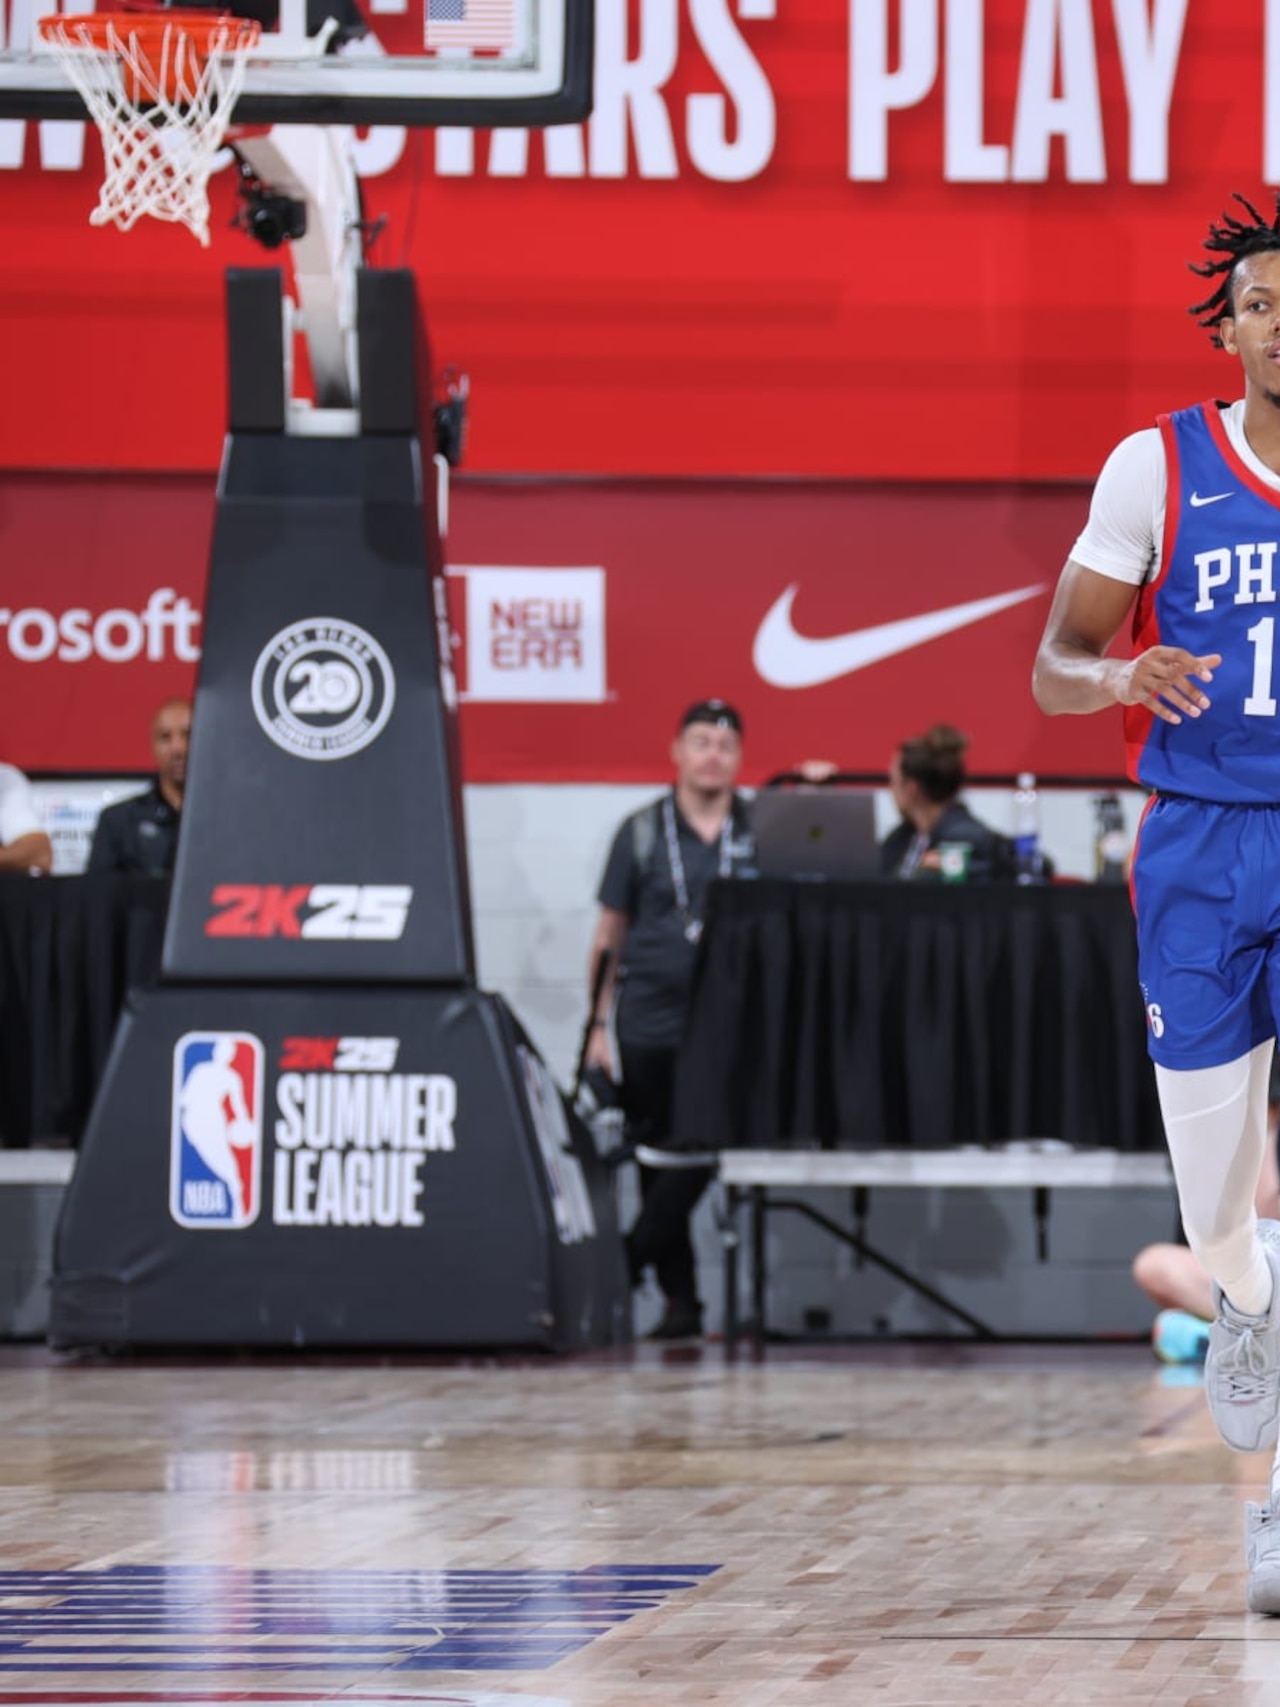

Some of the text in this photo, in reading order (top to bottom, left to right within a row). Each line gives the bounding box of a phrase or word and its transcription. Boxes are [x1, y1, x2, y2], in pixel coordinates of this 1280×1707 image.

[848, 0, 1188, 183] PLAY
[490, 599, 582, 631] NEW
[491, 636, 583, 671] ERA
[288, 659, 362, 714] 20
[204, 884, 414, 940] 2K25
[1147, 1003, 1164, 1038] 6
[277, 1036, 400, 1072] 2K25
[274, 1072, 458, 1151] SUMMER
[183, 1180, 229, 1217] NBA
[272, 1150, 426, 1227] LEAGUE
